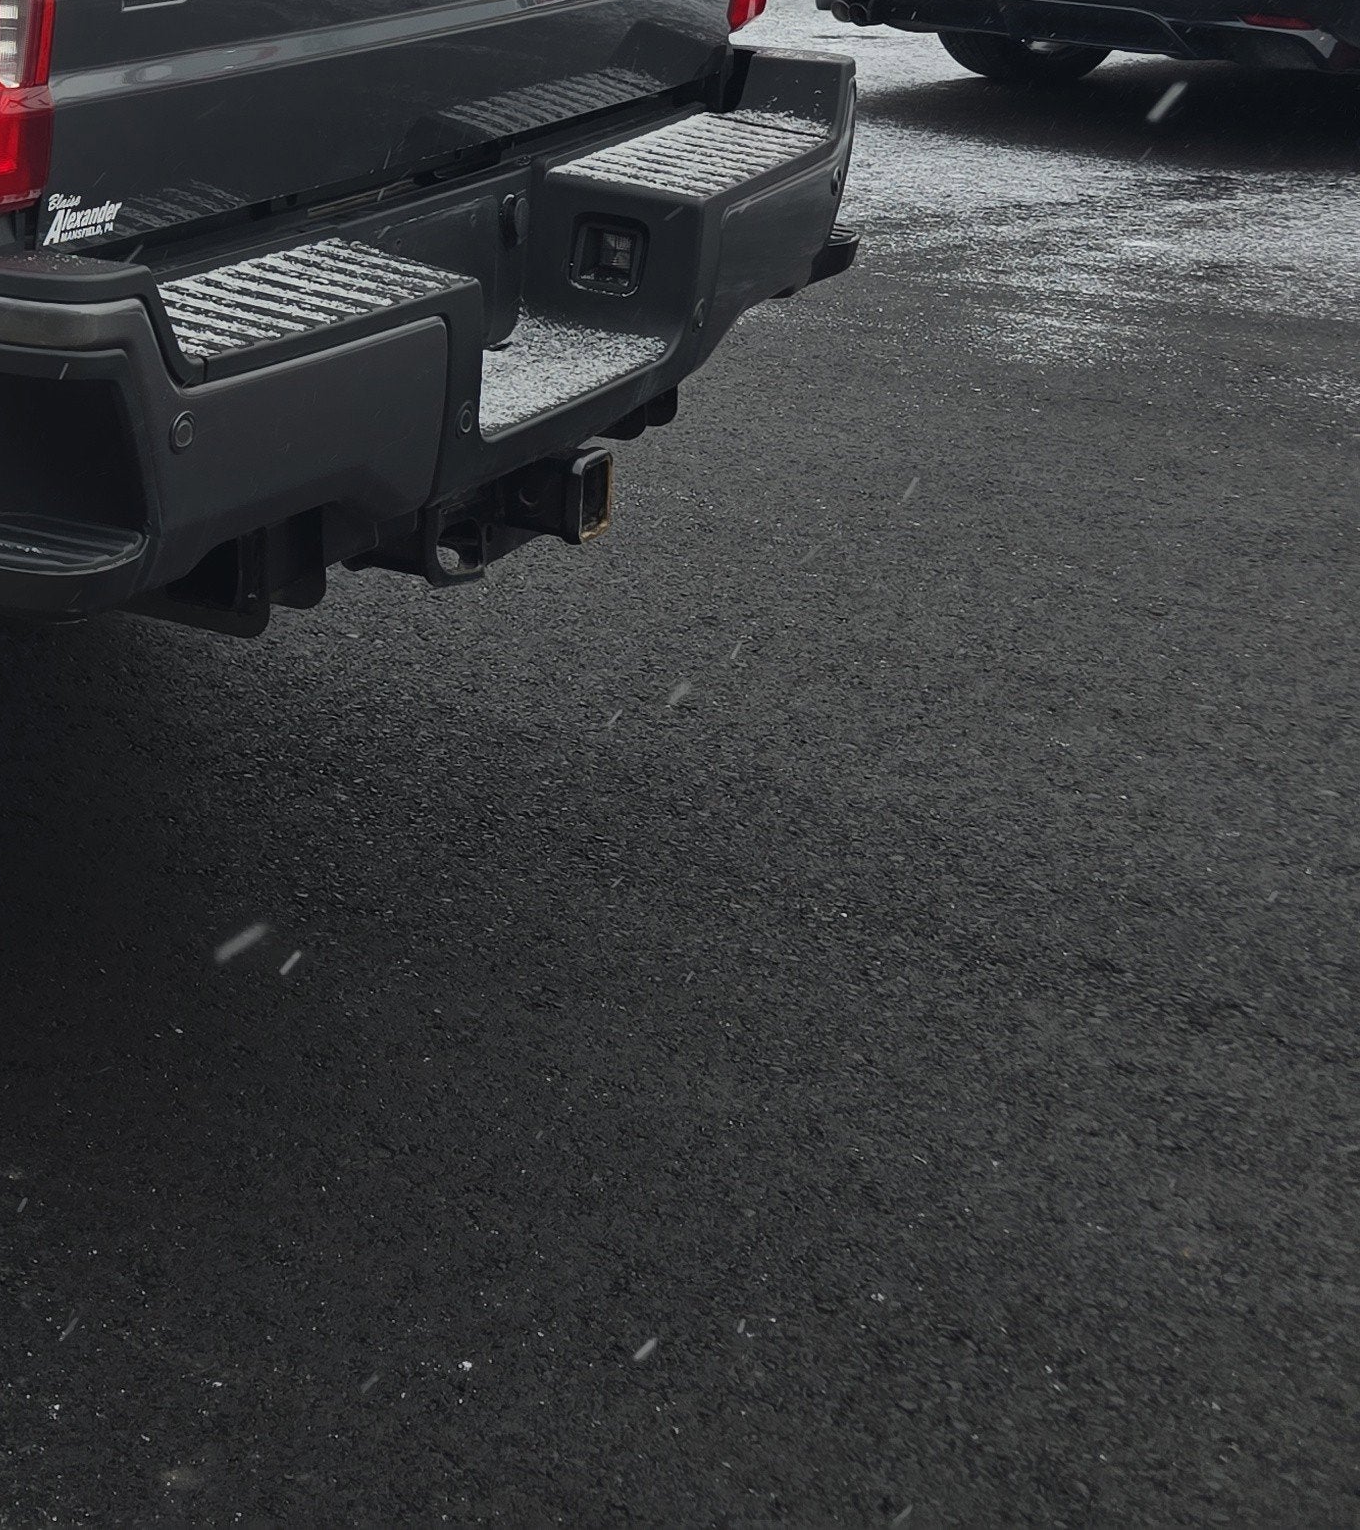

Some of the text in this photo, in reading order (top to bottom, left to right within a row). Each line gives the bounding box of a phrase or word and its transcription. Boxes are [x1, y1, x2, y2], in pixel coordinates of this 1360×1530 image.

[47, 193, 82, 212] Blaise
[42, 200, 123, 246] Alexander
[60, 221, 115, 243] MANSFIELD, PA
